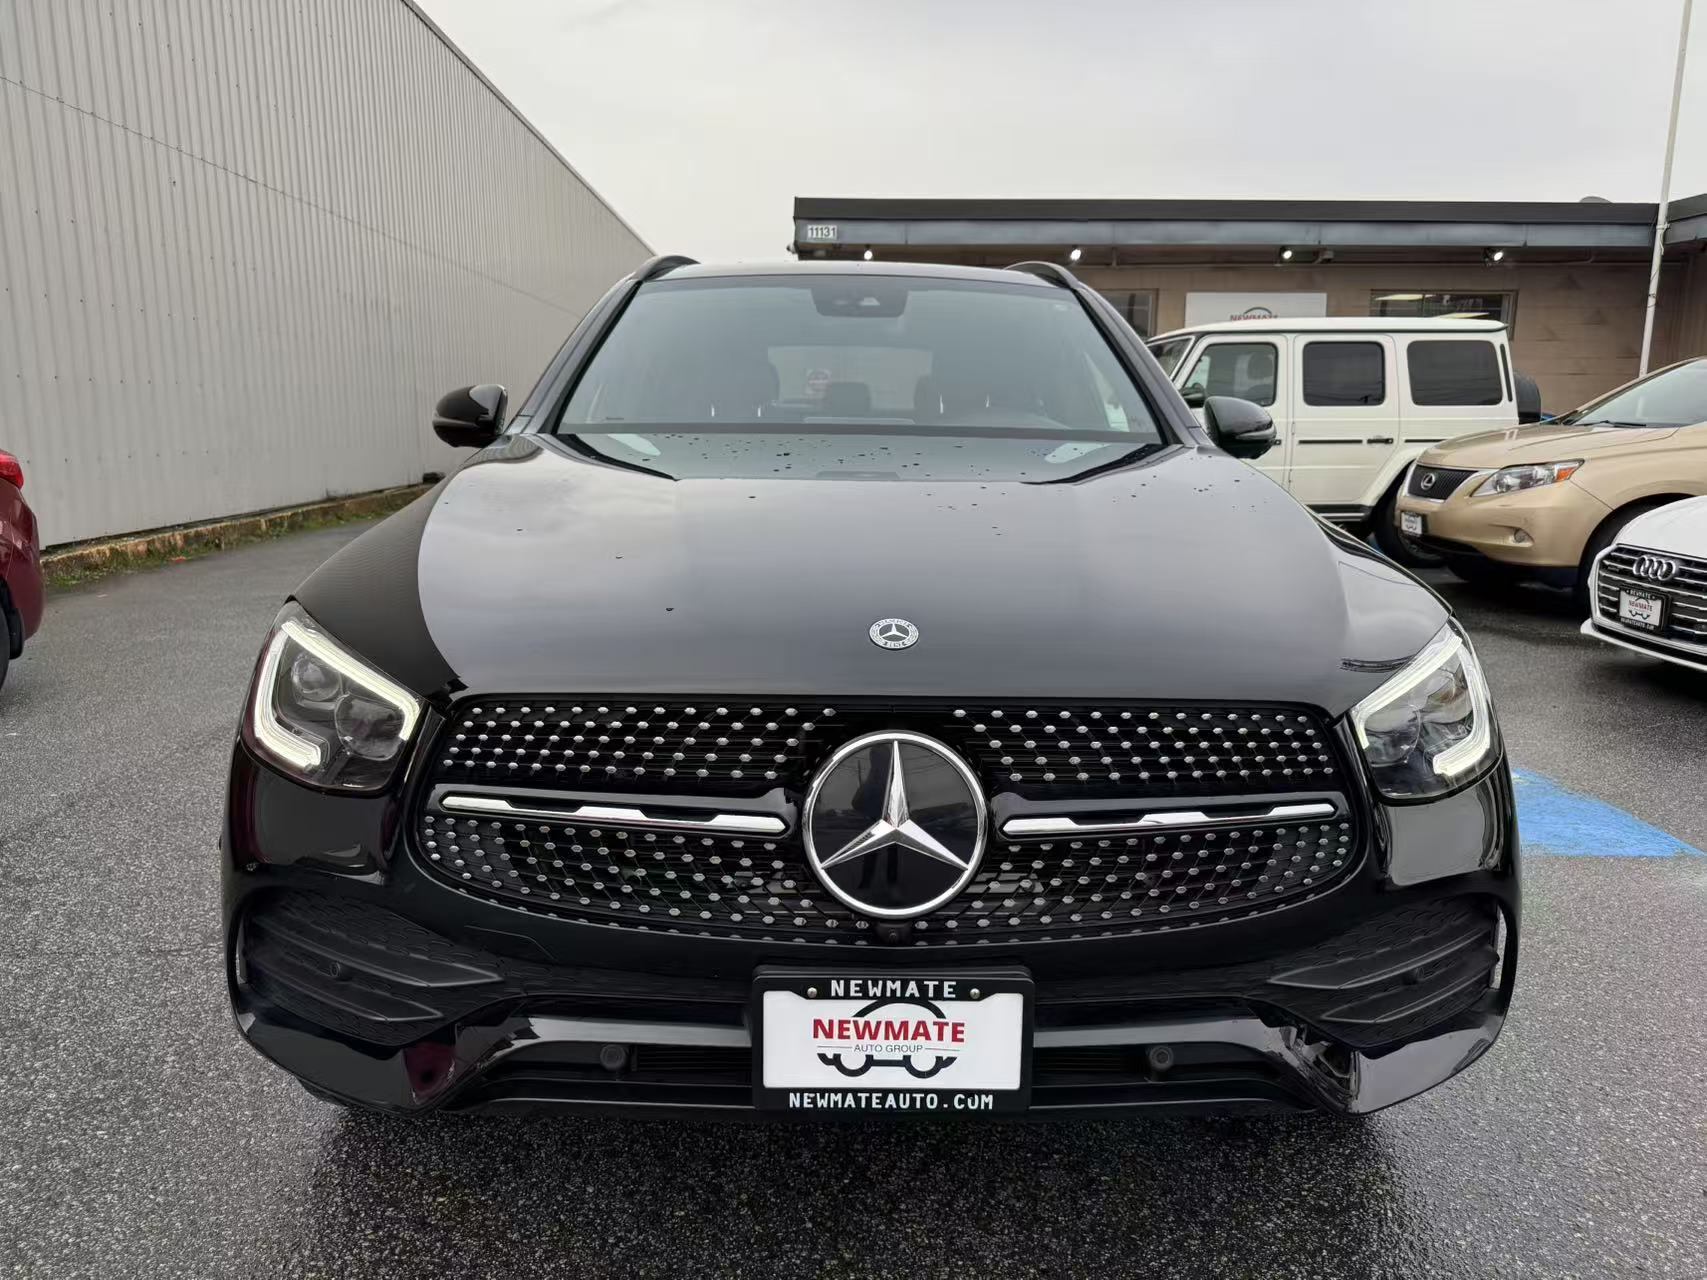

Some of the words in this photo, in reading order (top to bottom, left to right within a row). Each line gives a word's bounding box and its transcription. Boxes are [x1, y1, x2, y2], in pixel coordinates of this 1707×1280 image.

[808, 226, 836, 237] 11131
[830, 980, 956, 998] NEWMATE
[813, 1019, 965, 1043] NEWMATE
[854, 1044, 883, 1053] AUTO
[885, 1044, 923, 1053] GROUP
[789, 1092, 993, 1110] NEWMATEAUTO.COM
